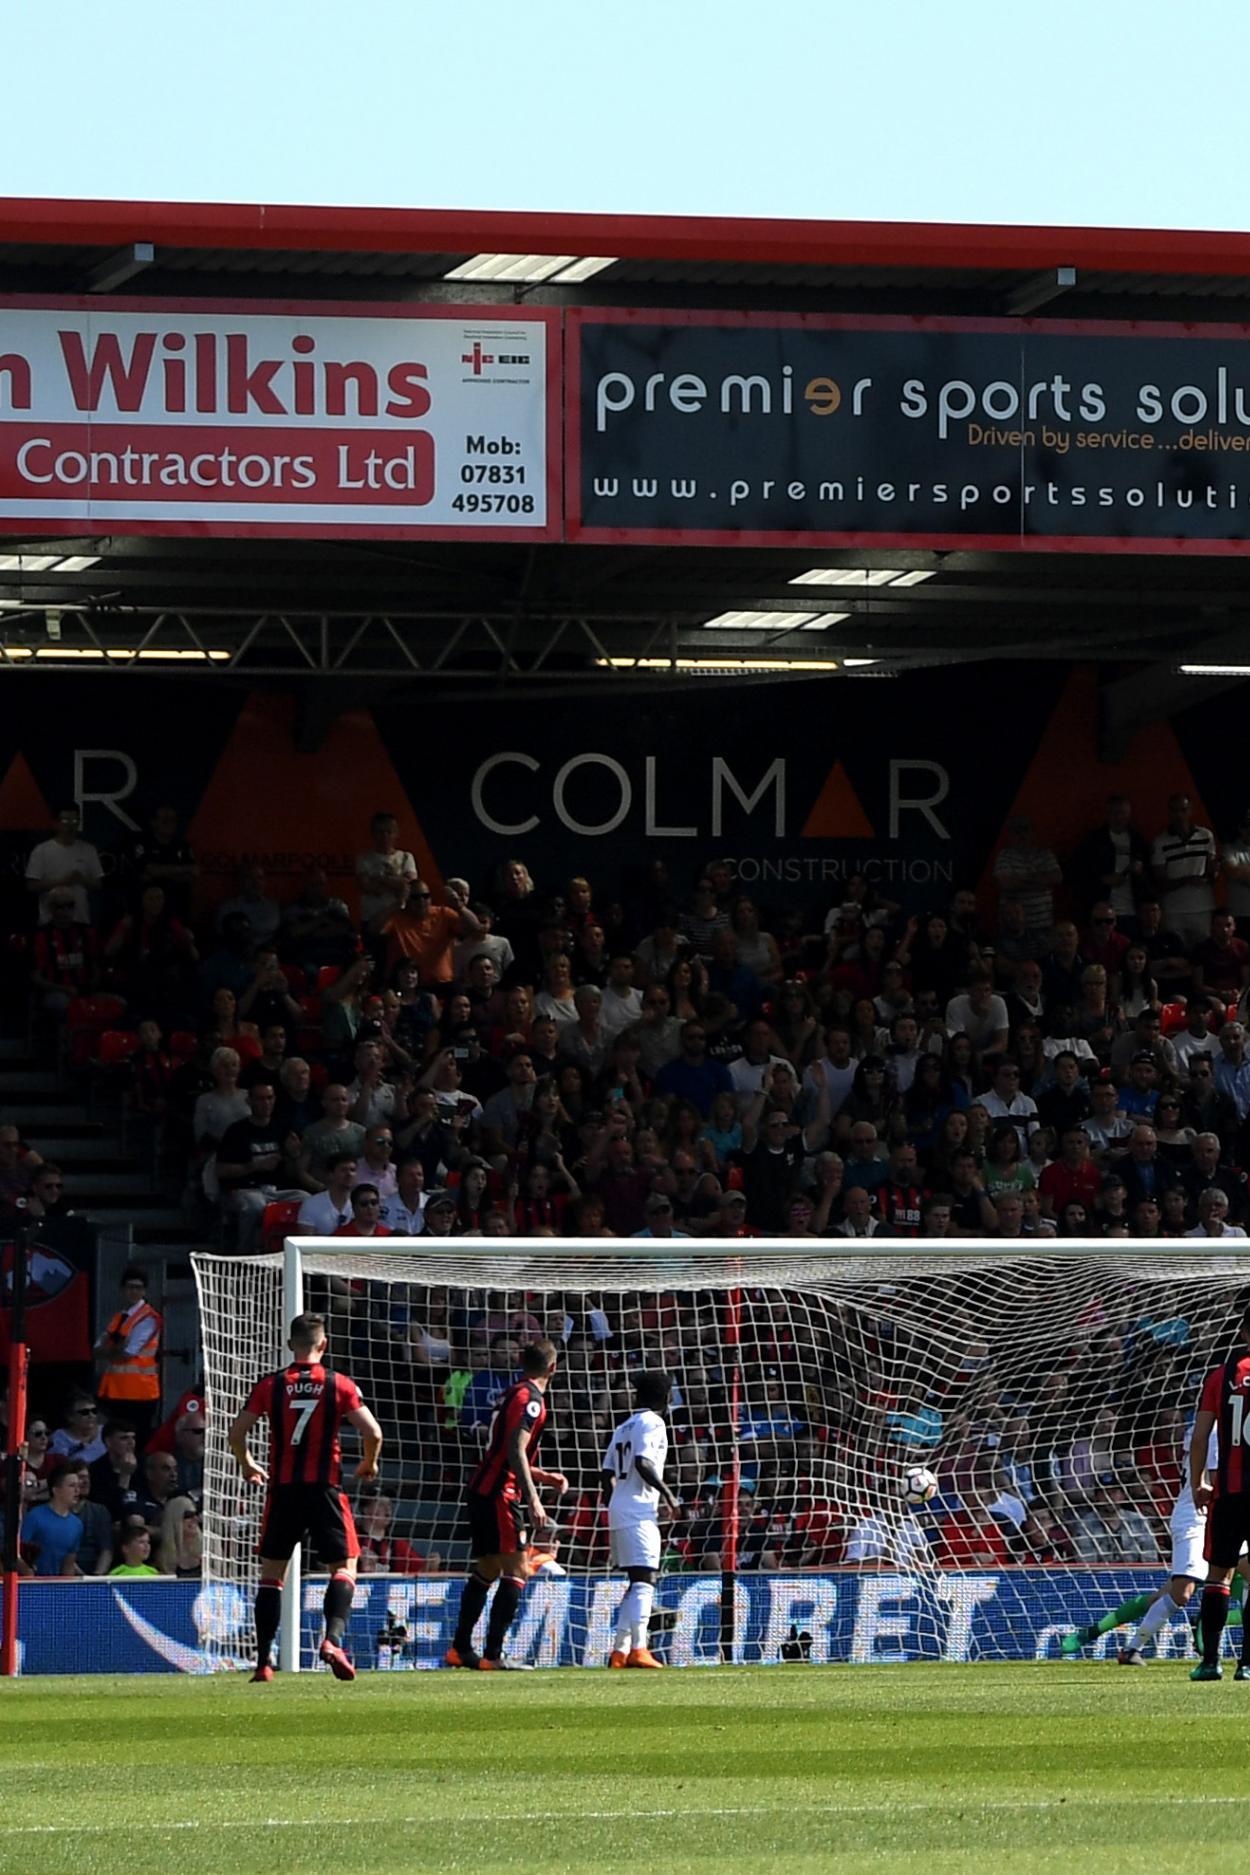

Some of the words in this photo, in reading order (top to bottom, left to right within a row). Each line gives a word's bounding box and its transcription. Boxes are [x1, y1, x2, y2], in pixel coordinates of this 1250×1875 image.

[57, 330, 432, 419] Wilkins
[596, 366, 873, 431] premier
[900, 373, 1107, 439] sports
[466, 434, 522, 457] Mob:
[967, 423, 1035, 448] Driven
[1042, 427, 1070, 454] by
[16, 438, 317, 488] Contractors
[337, 445, 416, 490] Ltd
[460, 464, 526, 485] 07831
[451, 493, 535, 515] 495708
[471, 751, 952, 841] COLMAR
[722, 857, 954, 883] CONSTRUCTION
[286, 1383, 324, 1396] PUGH
[289, 1400, 319, 1446] 7
